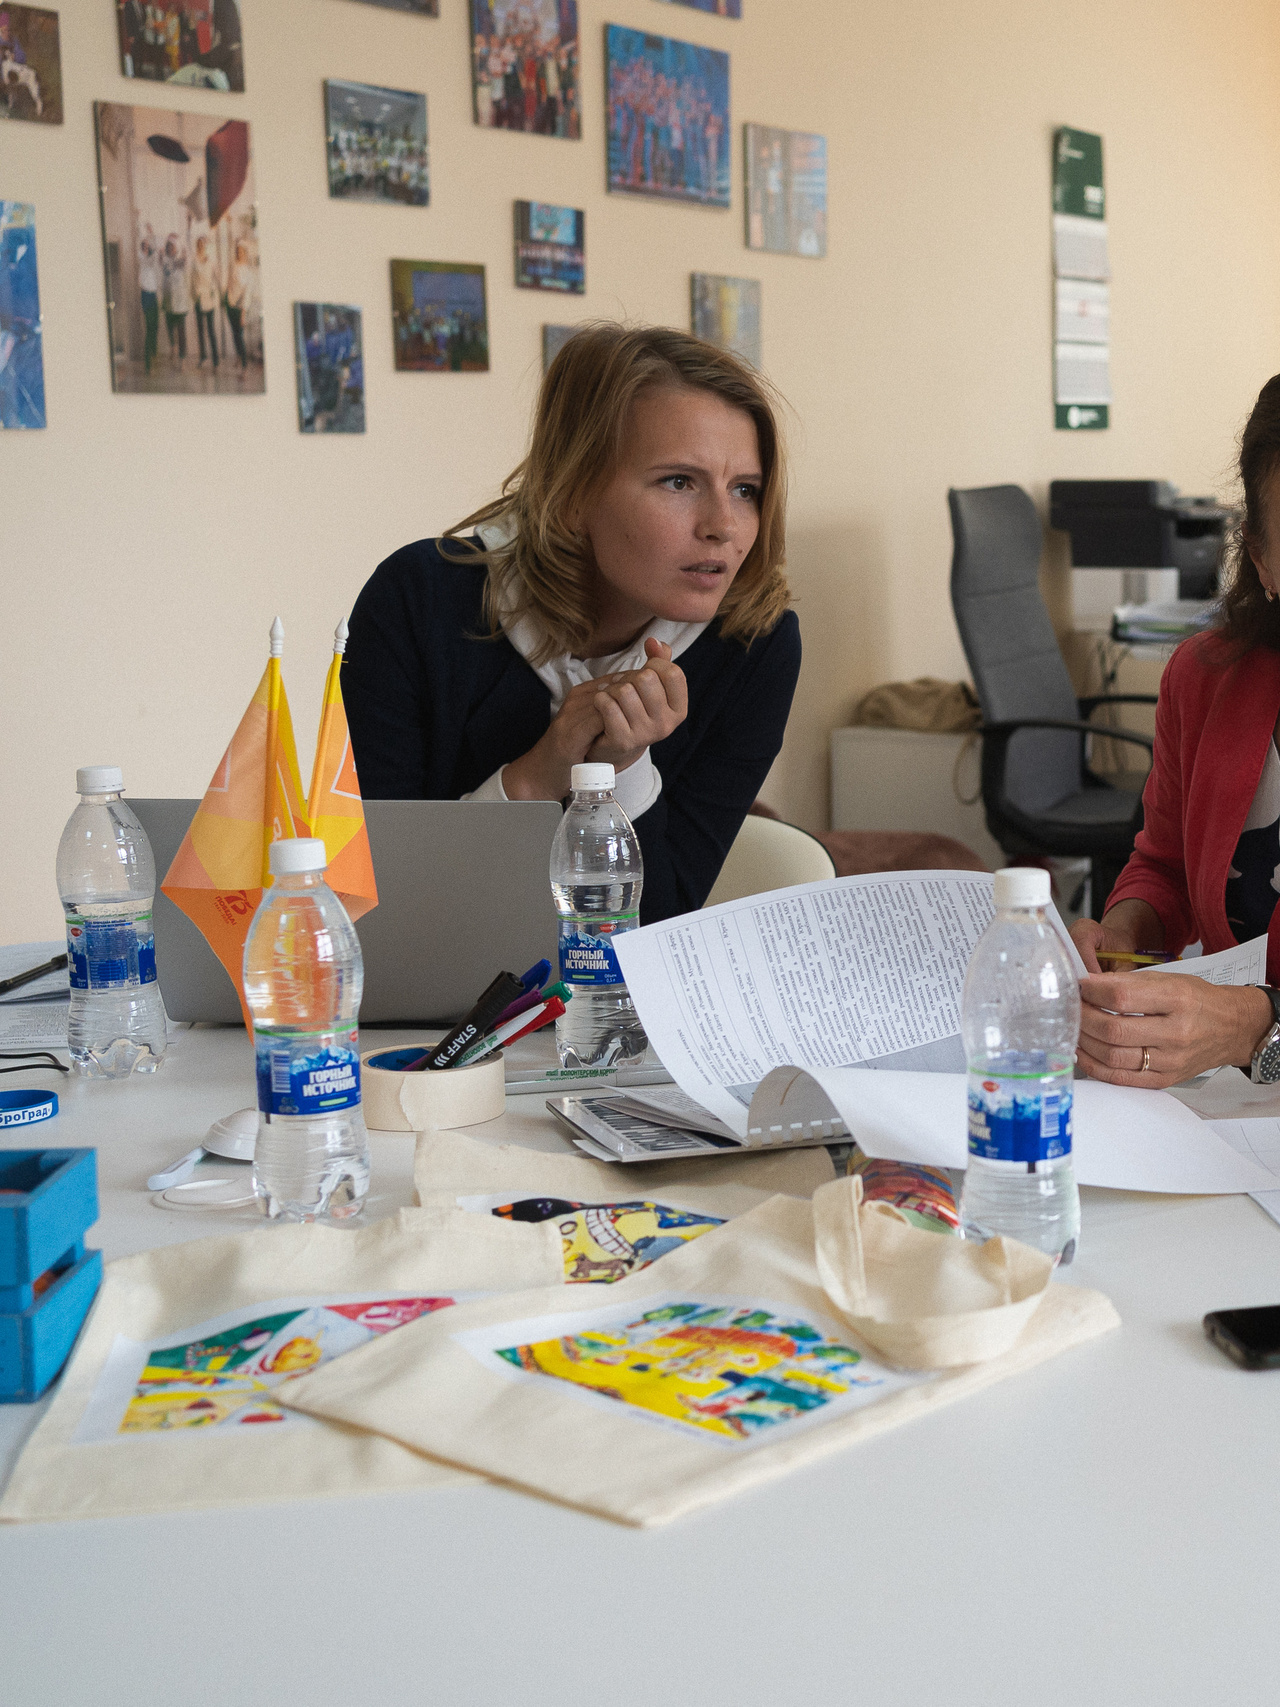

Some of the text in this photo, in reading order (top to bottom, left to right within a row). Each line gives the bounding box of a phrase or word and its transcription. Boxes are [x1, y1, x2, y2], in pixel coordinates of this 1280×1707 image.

[565, 959, 610, 970] ИСТОЧНИК
[568, 949, 604, 960] ГОРНЫЙ
[447, 1024, 477, 1057] STAFF
[309, 1064, 353, 1084] ГОРНЫЙ
[302, 1076, 357, 1097] ИСТОЧНИК
